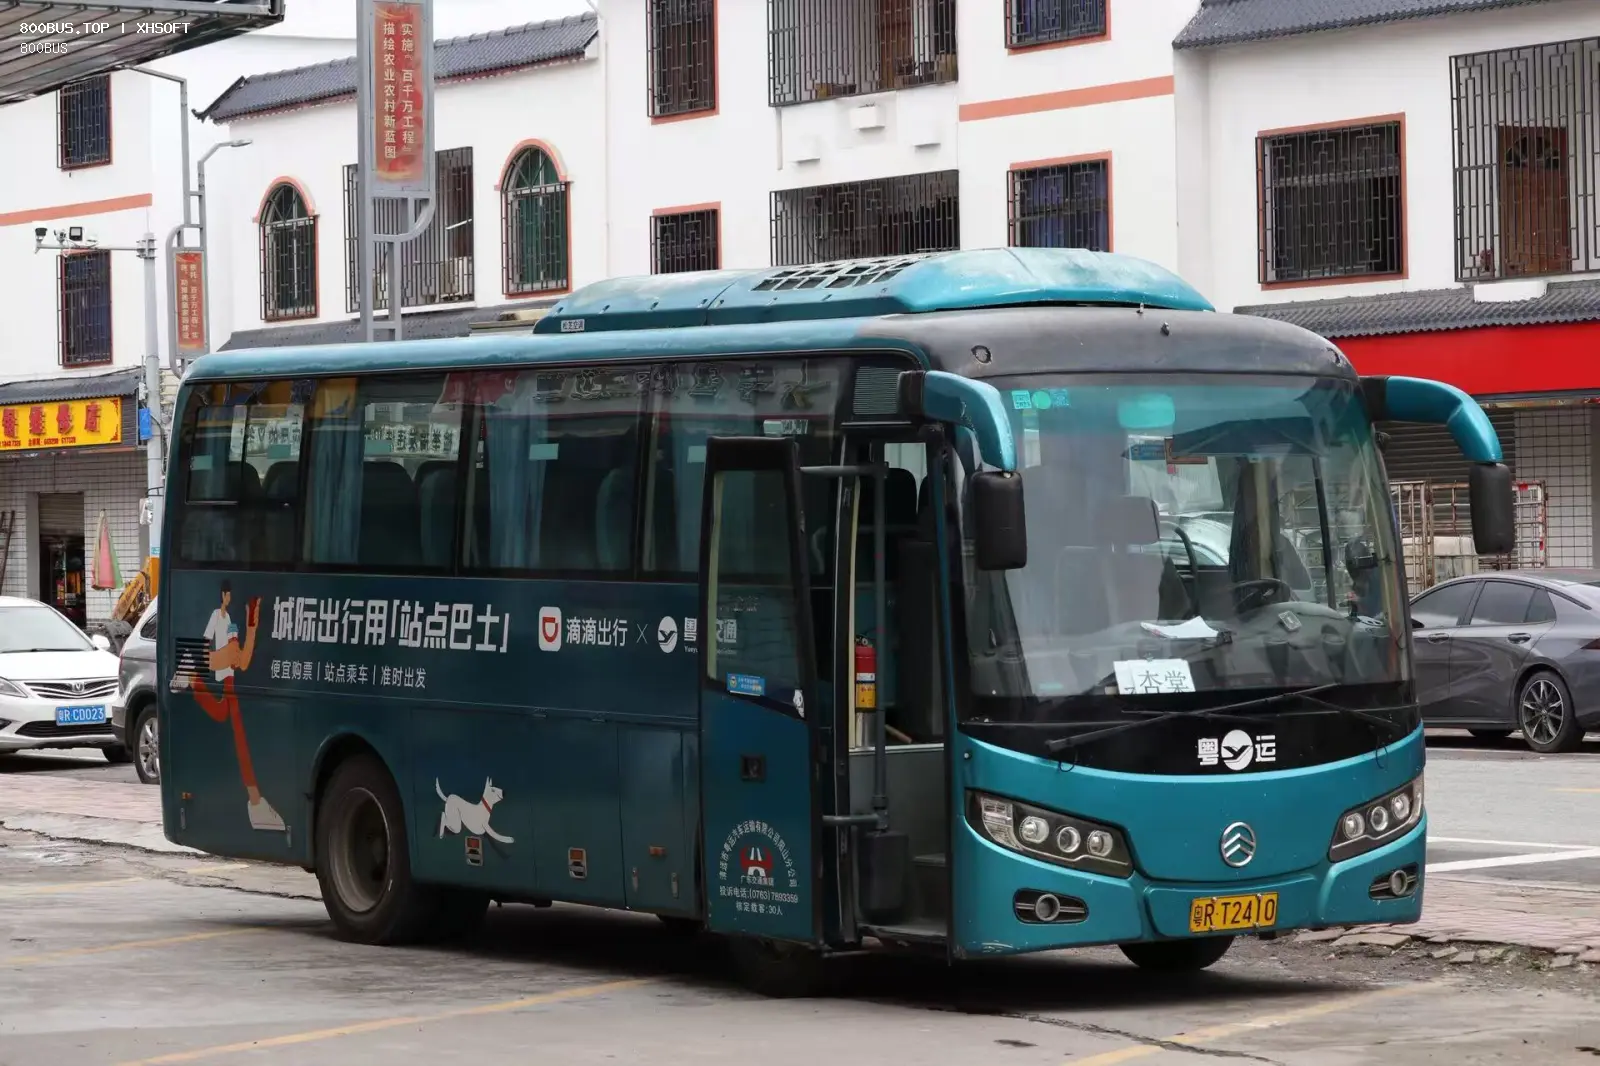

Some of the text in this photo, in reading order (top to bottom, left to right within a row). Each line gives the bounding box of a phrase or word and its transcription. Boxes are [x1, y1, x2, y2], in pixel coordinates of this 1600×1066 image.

[383, 22, 397, 159] 描绘农业农村新蓝图
[566, 616, 628, 647] 滴滴出行
[270, 659, 313, 681] 便宜购票
[324, 661, 369, 685] 站点乘车
[380, 665, 427, 689] 准时出发
